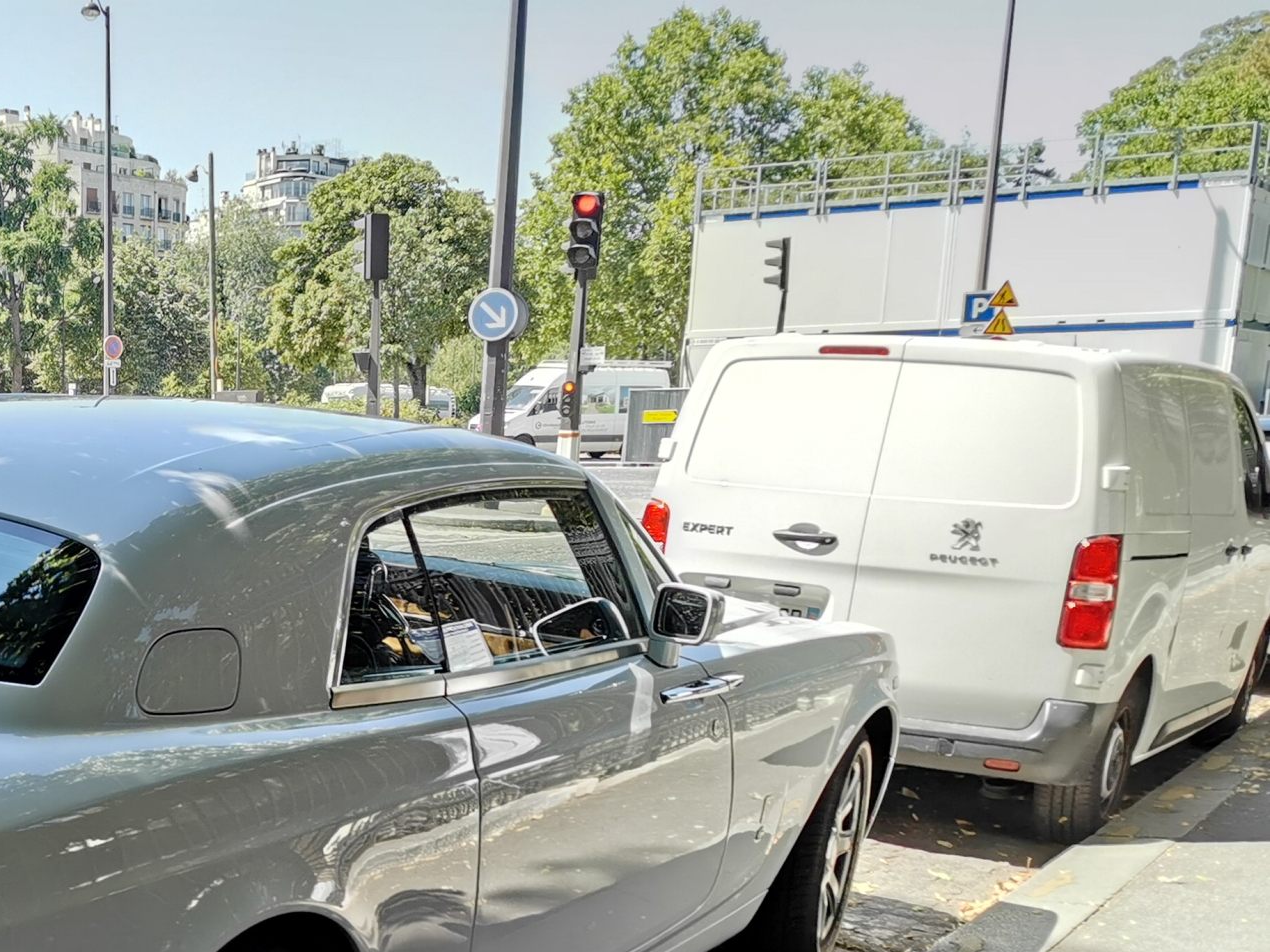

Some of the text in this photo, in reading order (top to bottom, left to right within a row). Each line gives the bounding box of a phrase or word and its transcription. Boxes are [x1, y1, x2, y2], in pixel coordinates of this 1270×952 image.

[971, 297, 990, 319] P
[682, 521, 734, 536] EXPERT
[929, 553, 999, 568] PEUGEOT
